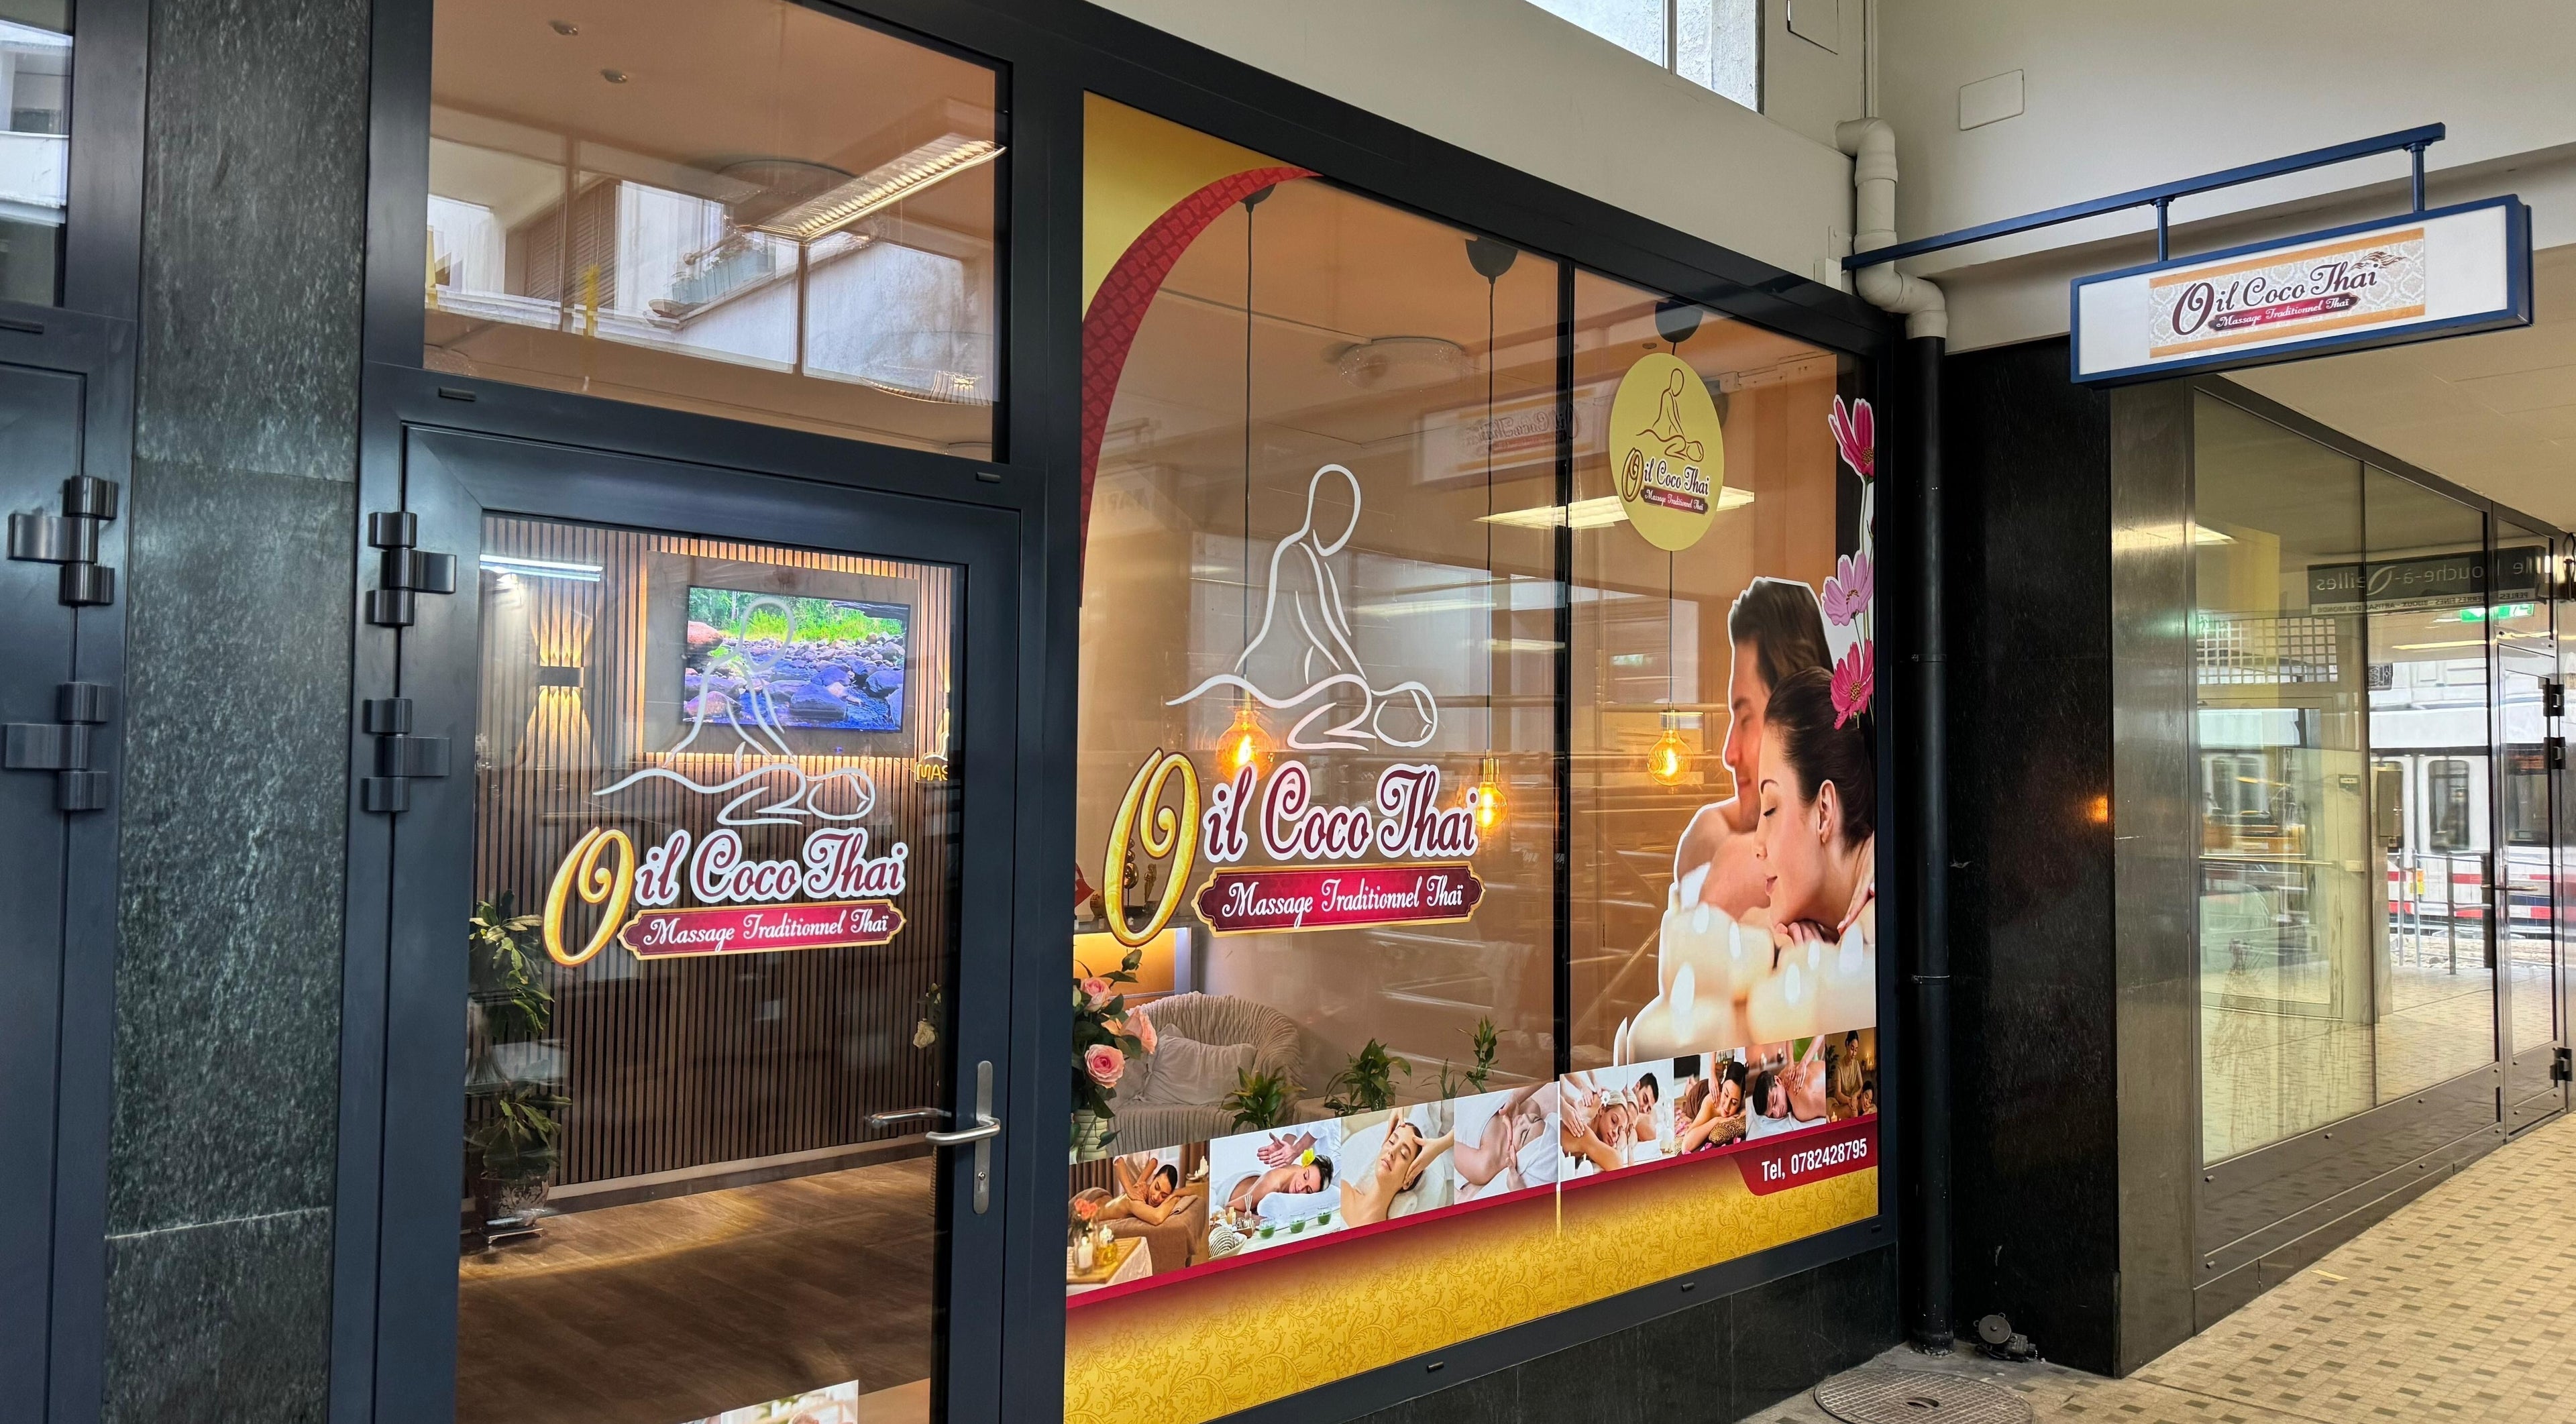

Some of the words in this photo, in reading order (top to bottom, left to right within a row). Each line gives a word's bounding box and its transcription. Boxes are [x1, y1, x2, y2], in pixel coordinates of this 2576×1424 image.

[2172, 280, 2239, 335] Oil
[2243, 276, 2306, 307] Coco
[2310, 260, 2379, 295] Thai
[2216, 315, 2261, 327] Massage
[2265, 300, 2323, 319] Traditionnel
[1621, 447, 1654, 502] Oil
[1656, 459, 1682, 489] Coco
[1684, 465, 1709, 495] Thai
[1645, 489, 1666, 506] Massage
[1667, 494, 1693, 508] Traditionnel
[1103, 747, 1255, 947] Oil
[1263, 763, 1371, 857] Coco
[1378, 765, 1479, 855] Thai
[543, 826, 690, 967] Oil
[693, 832, 798, 899] Coco
[805, 829, 907, 895] Thai
[1222, 882, 1313, 929] Massage
[1321, 875, 1421, 913] Traditionnel
[1426, 874, 1463, 907] Thaï
[643, 918, 735, 952] Massage
[743, 910, 846, 939] Traditionnel
[849, 908, 888, 934] Thaï
[1762, 1158, 1785, 1182] Tel,
[1791, 1138, 1867, 1174] 0782428795
